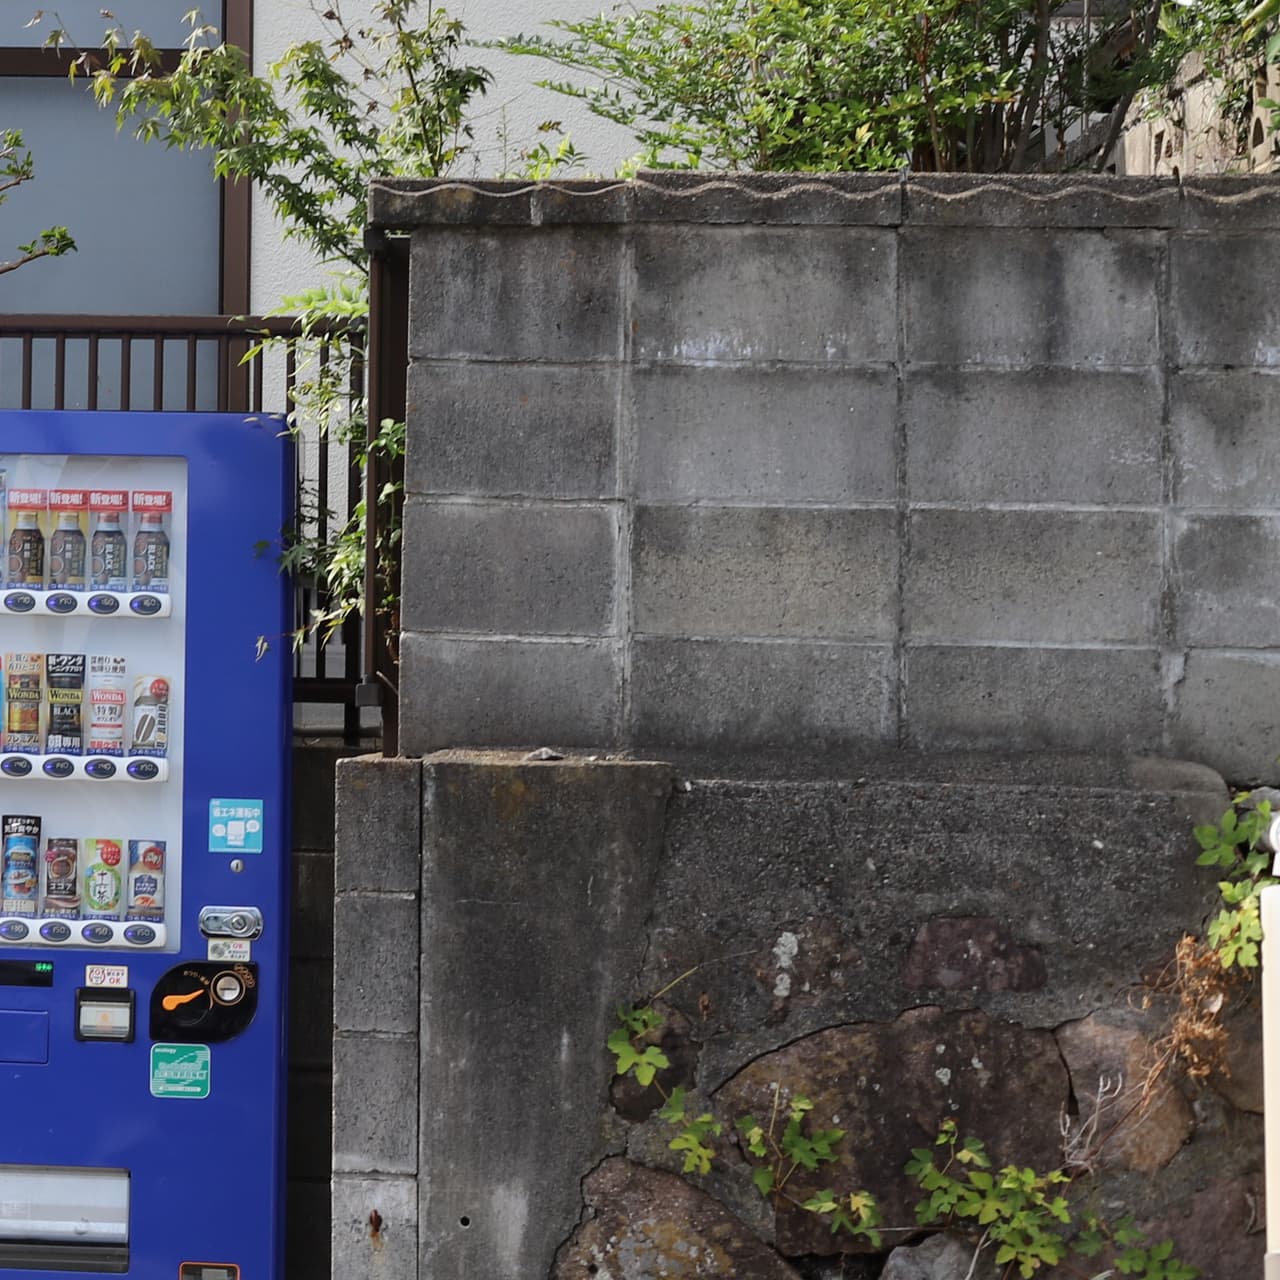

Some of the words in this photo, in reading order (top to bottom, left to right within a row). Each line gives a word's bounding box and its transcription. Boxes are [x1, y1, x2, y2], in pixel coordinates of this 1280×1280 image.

[8, 688, 40, 700] WONDA
[50, 690, 81, 701] WONDA
[92, 690, 124, 702] WONDA
